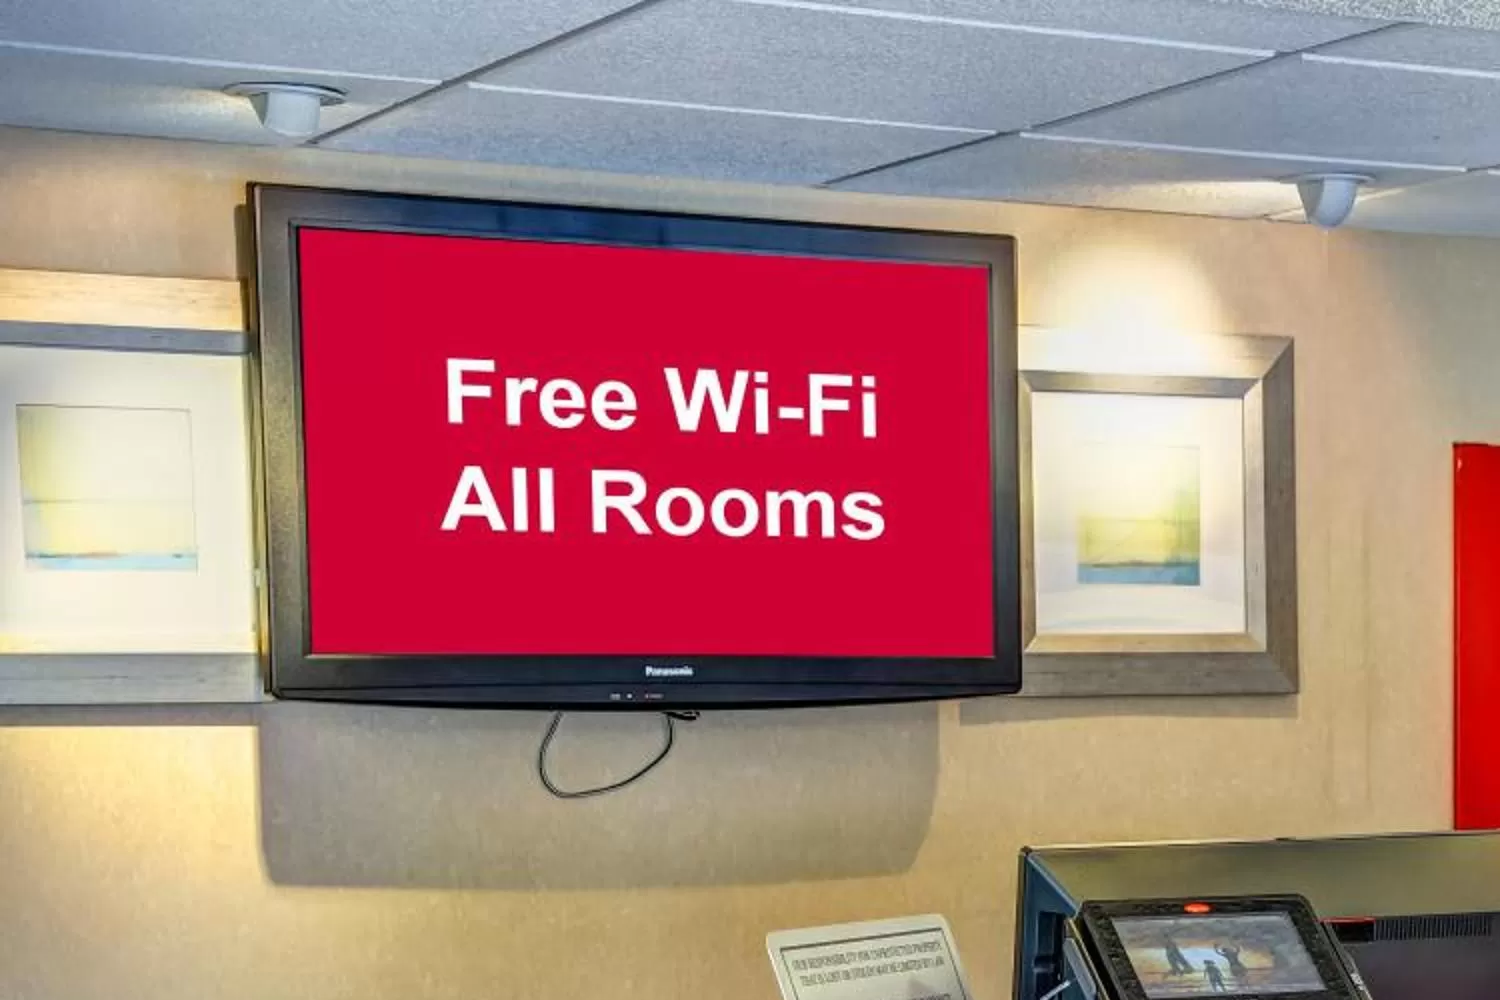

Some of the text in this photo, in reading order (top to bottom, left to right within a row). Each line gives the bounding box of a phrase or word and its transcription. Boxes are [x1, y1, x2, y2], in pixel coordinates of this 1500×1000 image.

[447, 357, 877, 438] Free Wi-Fi
[441, 465, 885, 541] All Rooms
[645, 665, 695, 678] Panasonic
